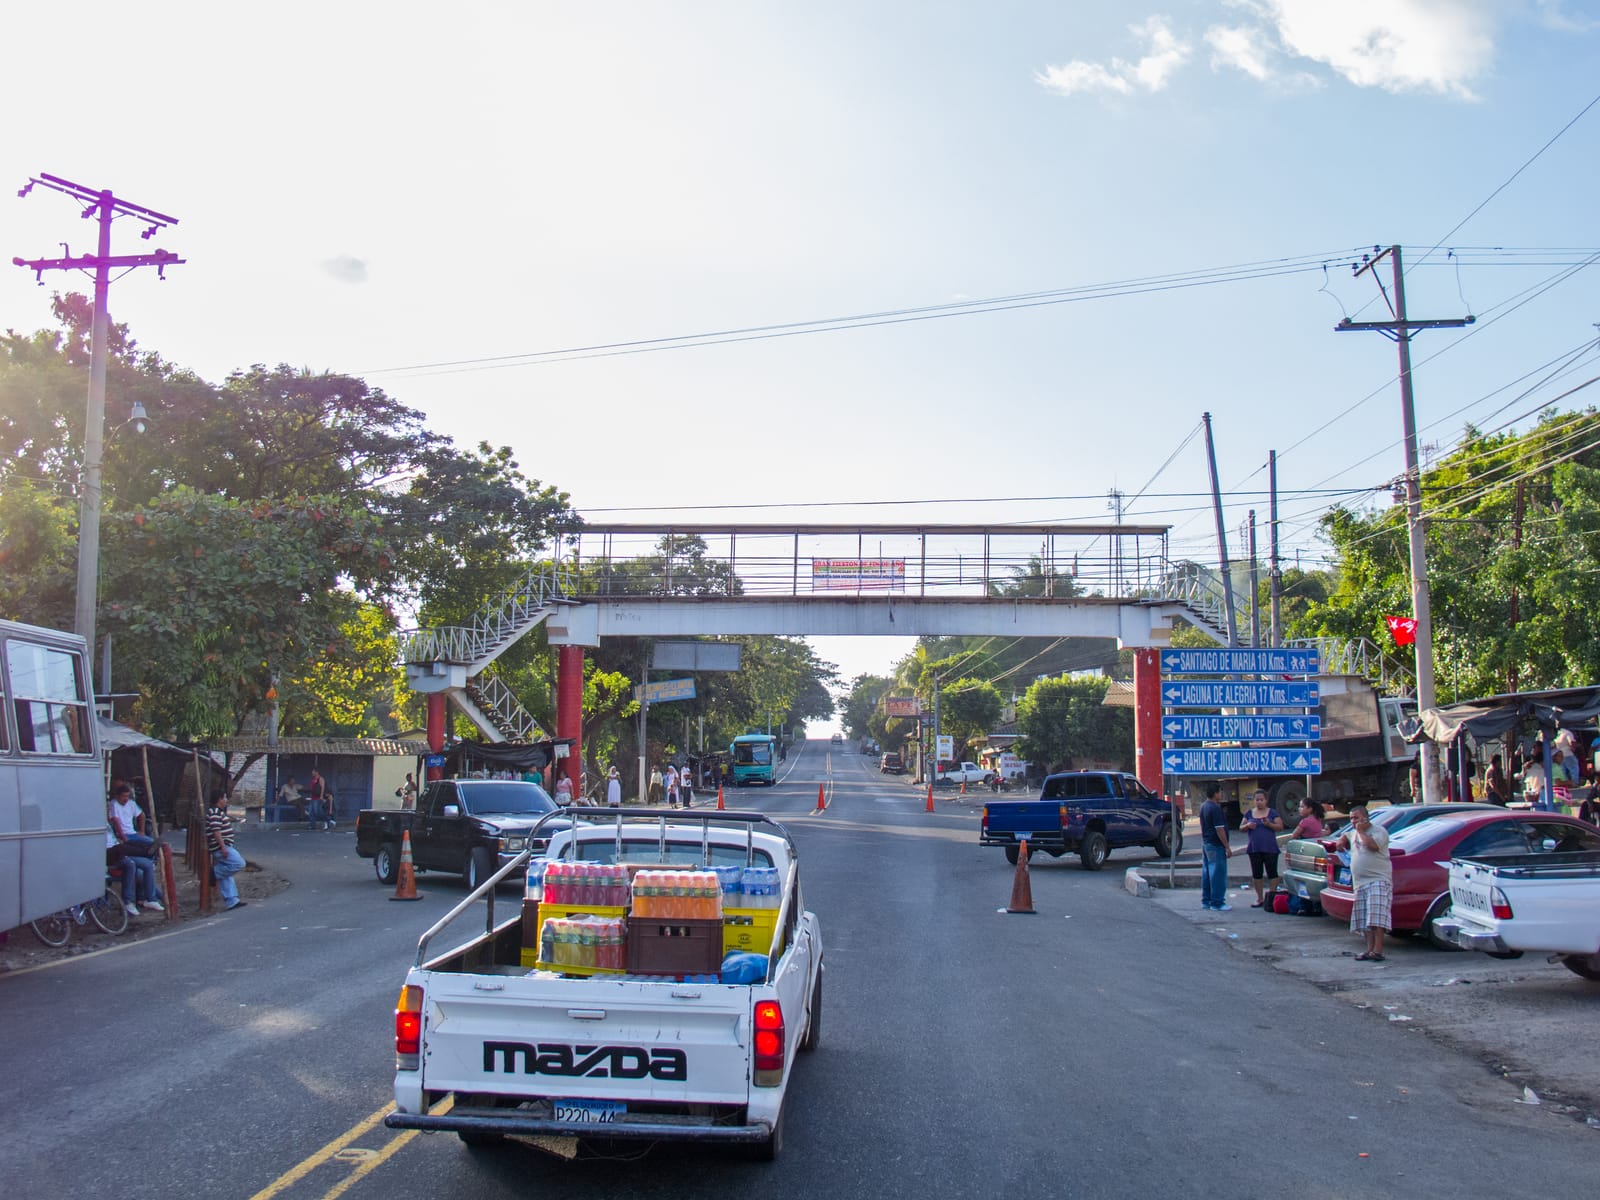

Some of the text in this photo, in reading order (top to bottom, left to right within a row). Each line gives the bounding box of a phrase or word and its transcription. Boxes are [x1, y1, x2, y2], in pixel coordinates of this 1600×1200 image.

[1180, 652, 1287, 671] SANTIAGO DE MARIA 10 Kms.
[1181, 685, 1288, 704] LAGUNA DE ALEGRIA 17 Kms.
[1183, 718, 1287, 738] PLAYA EL ESPINO 75 Kms.
[1184, 752, 1289, 772] BAHIA DE JIQUILISCO 52 Kms.
[1453, 886, 1489, 912] MITSUBISHI
[556, 1107, 590, 1123] P220
